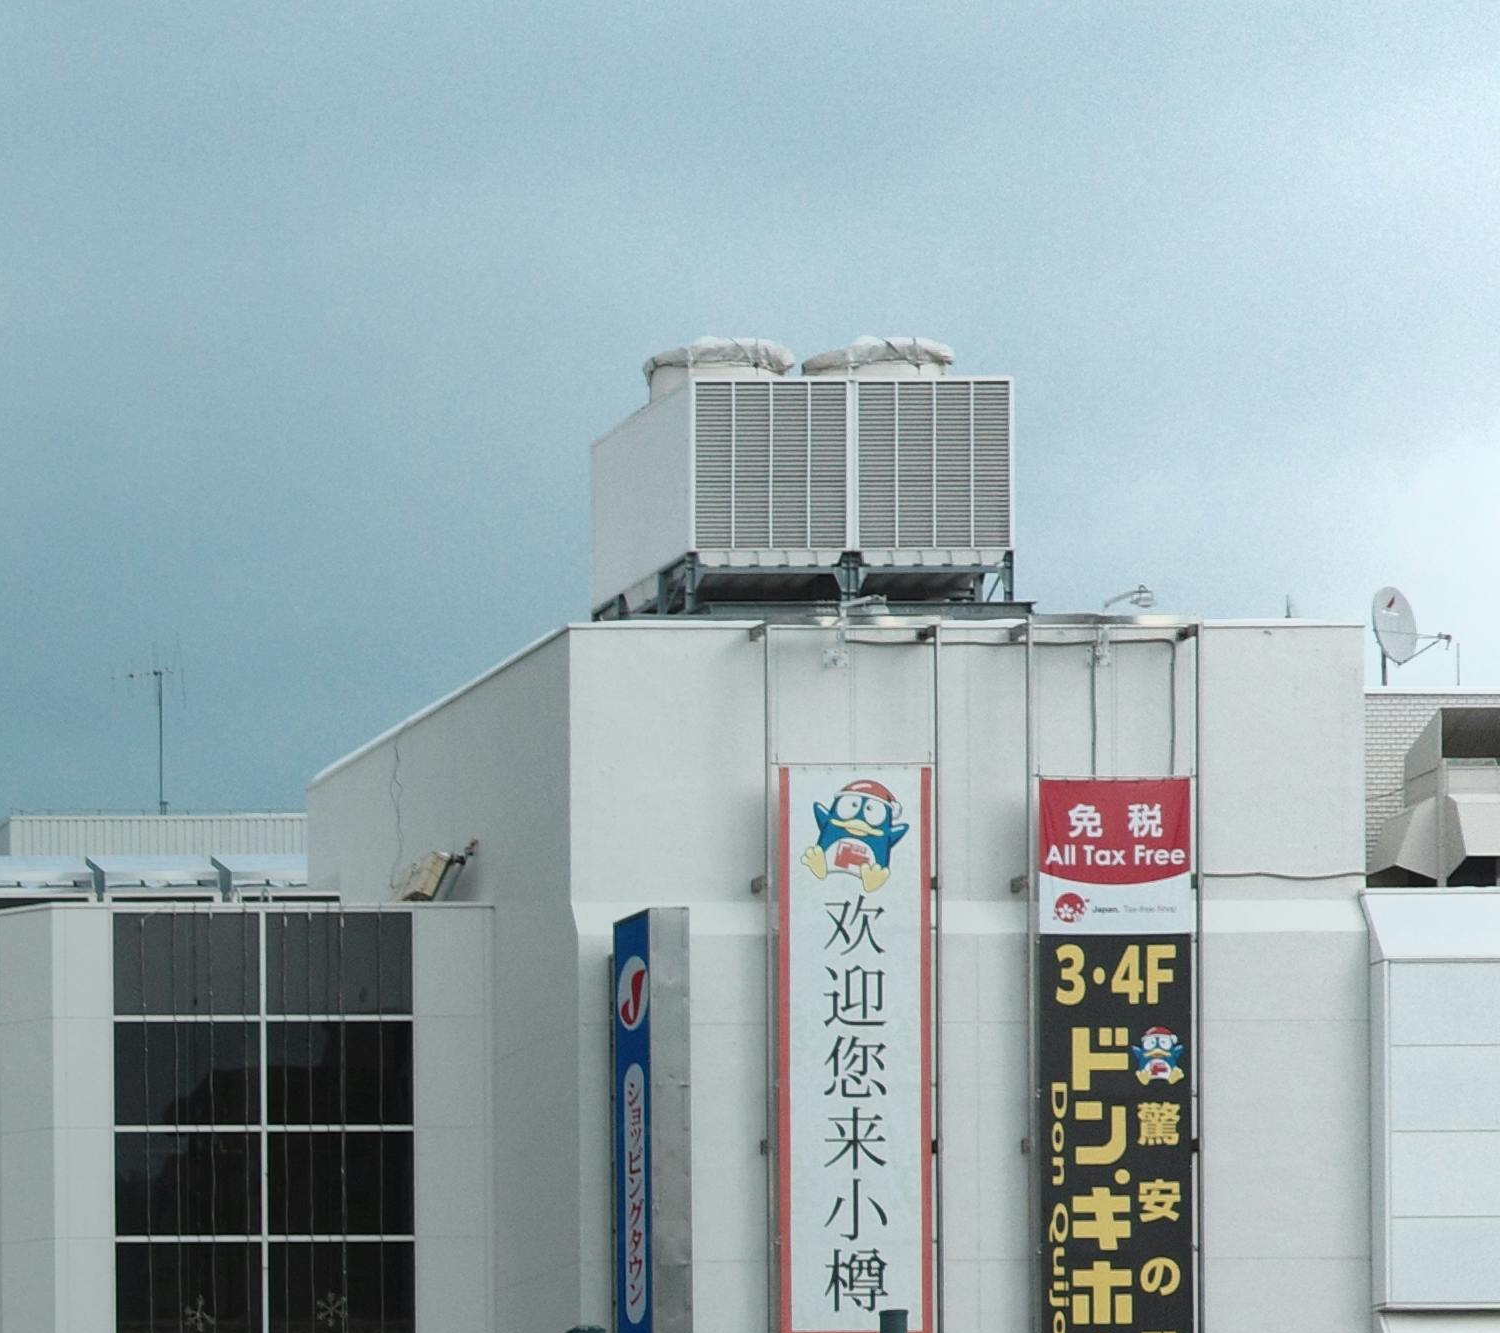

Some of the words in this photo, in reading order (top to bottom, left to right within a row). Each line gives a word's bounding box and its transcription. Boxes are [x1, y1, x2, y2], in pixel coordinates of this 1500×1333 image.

[1045, 844, 1077, 866] All
[1083, 844, 1127, 866] Tax
[1133, 844, 1187, 866] Free
[1068, 803, 1164, 839] 免税
[822, 894, 889, 1313] 欢迎您来小樽
[1050, 1082, 1067, 1187] Don
[626, 1083, 646, 1308] ショッピングタウン
